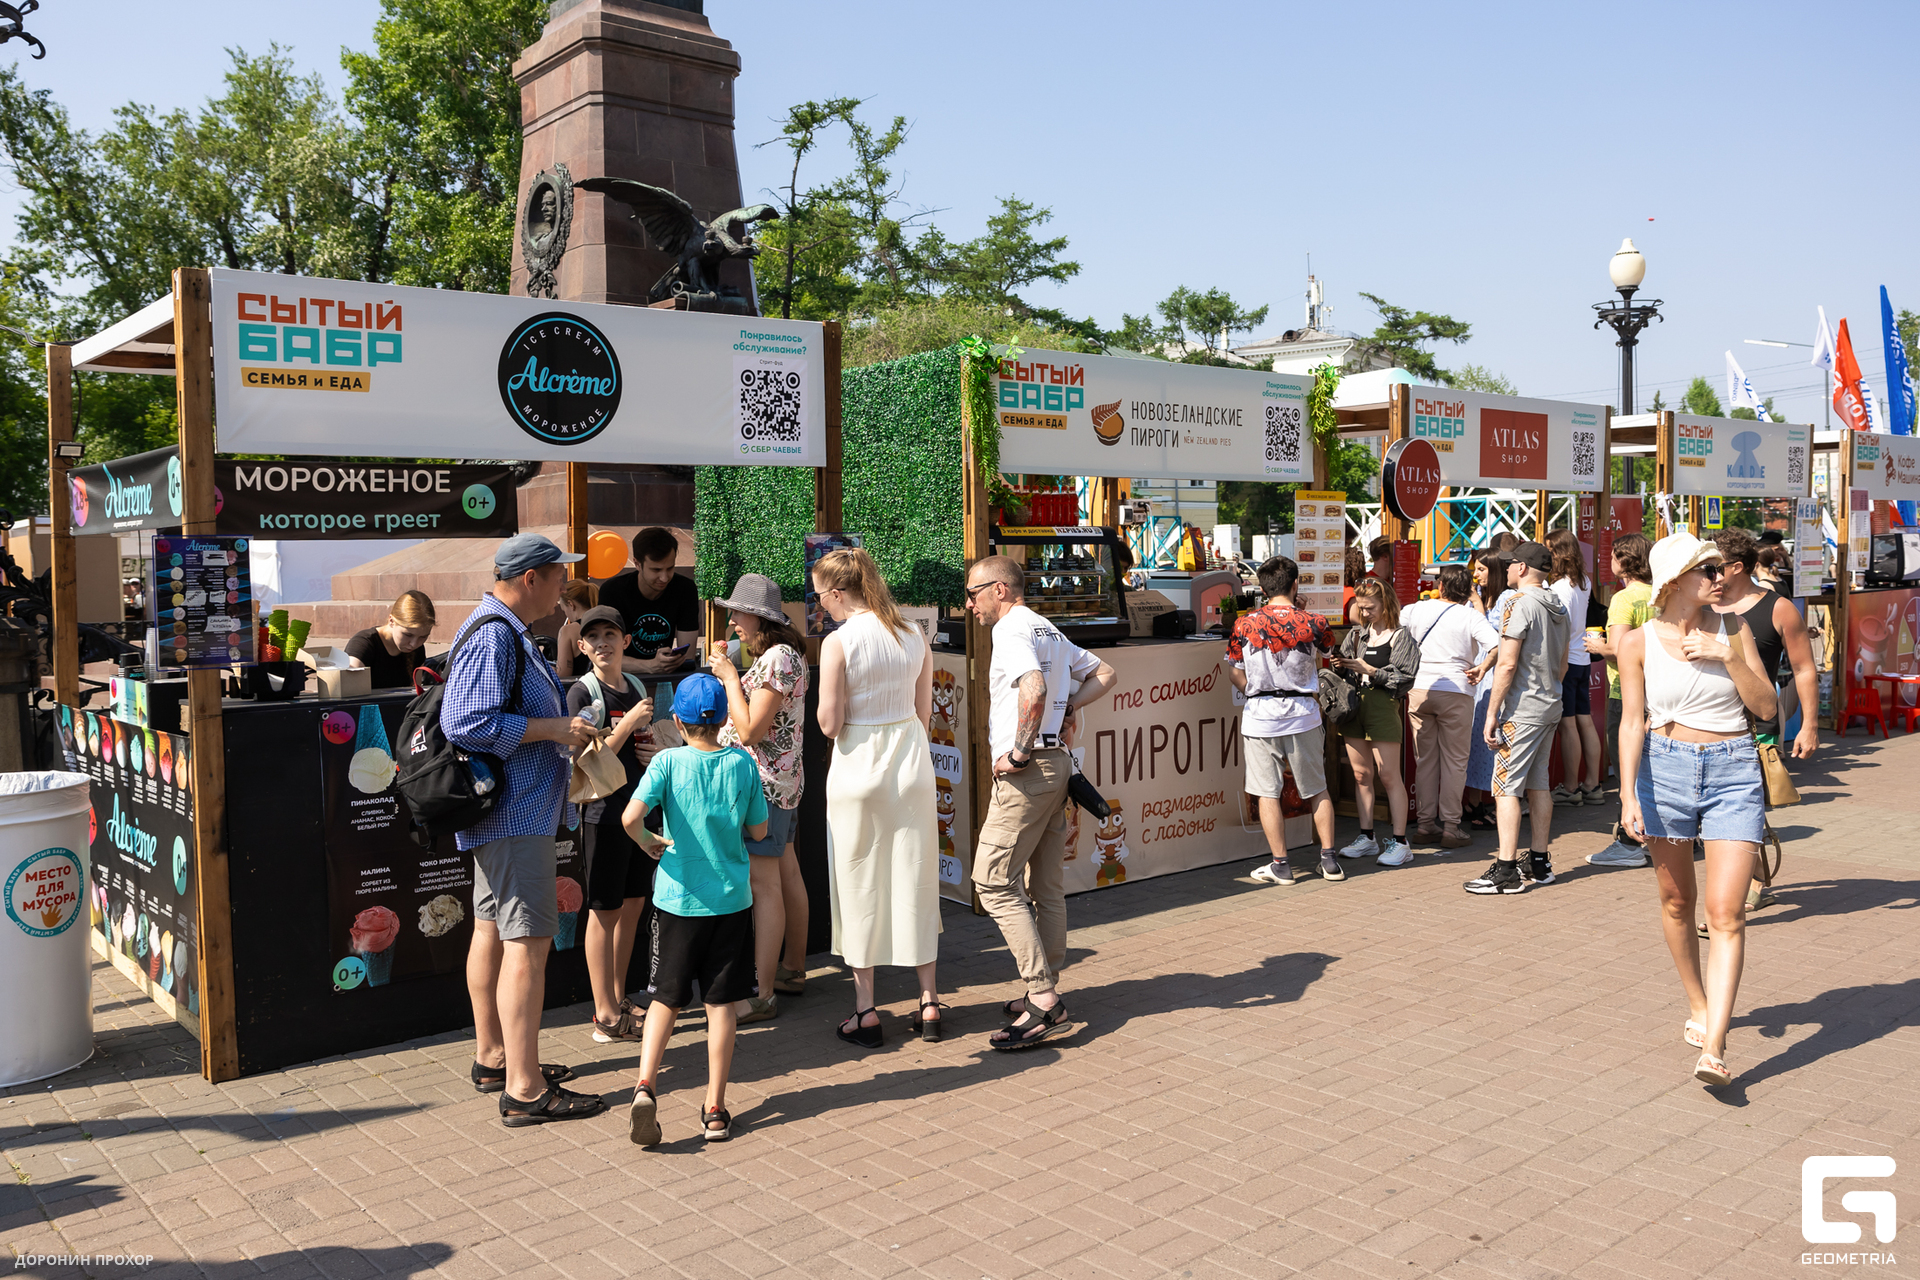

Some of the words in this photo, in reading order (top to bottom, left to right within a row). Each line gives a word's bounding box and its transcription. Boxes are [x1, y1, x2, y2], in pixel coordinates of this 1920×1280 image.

[238, 292, 402, 331] СЫТЫЙ
[523, 330, 546, 350] ICE
[554, 326, 602, 356] CREAM
[740, 330, 802, 343] Понравилось
[239, 323, 402, 367] БАБР
[733, 342, 807, 355] обслуживание?
[248, 372, 307, 386] СЕМЬЯ
[314, 378, 322, 386] и
[330, 376, 362, 390] ЕДА
[1266, 381, 1302, 390] Понравилось
[999, 381, 1084, 412] БАБР
[1262, 390, 1304, 400] обслуживание?
[1132, 401, 1243, 427] НОВОЗЕЛАНДСКИЕ
[1416, 398, 1464, 418] СЫТЫЙ
[523, 405, 602, 433] МОРОЖЕНОЕ
[1004, 416, 1034, 426] СЕМЬЯ
[1046, 418, 1063, 428] ЕДА
[1416, 415, 1464, 438] БАБР
[1132, 427, 1179, 448] ПИРОГИ
[1490, 428, 1540, 450] ATLAS
[1678, 424, 1713, 439] СЫТЫЙ
[1184, 436, 1194, 444] NEW
[1196, 436, 1218, 446] ZEALAND
[1220, 438, 1232, 446] PIES
[1678, 438, 1713, 456] БАБР
[1858, 434, 1879, 446] СЫТЫЙ
[1502, 454, 1528, 464] SHOP
[1858, 446, 1879, 460] БАБР
[1898, 454, 1915, 470] Кофе
[235, 466, 450, 492] МОРОЖЕНОЕ
[1397, 466, 1440, 484] ATLAS
[1727, 464, 1765, 478] KADE
[468, 496, 489, 509] 0+
[260, 514, 366, 533] которое
[374, 514, 441, 532] греет
[1114, 688, 1144, 711] те
[1150, 673, 1214, 703] самые
[326, 722, 351, 734] 18+
[411, 746, 427, 755] FILA
[1096, 716, 1238, 787] ПИРОГИ
[1142, 790, 1226, 823] размером
[1142, 828, 1150, 844] с
[1154, 817, 1217, 842] ладонь
[28, 850, 50, 863] СЫТЫЙ
[420, 859, 438, 867] ЧОКО
[439, 857, 460, 865] КРАНЧ
[26, 865, 71, 883] МЕСТО
[360, 867, 390, 876] МАЛИНА
[421, 874, 460, 885] КАРАМЕЛЬНЫЙ
[36, 881, 64, 897] ДЛЯ
[372, 885, 397, 893] МАЛИНЫ
[414, 883, 453, 893] ШОКОЛАДНЫЙ
[23, 892, 76, 911] МУСОРА
[338, 966, 363, 981] 0+
